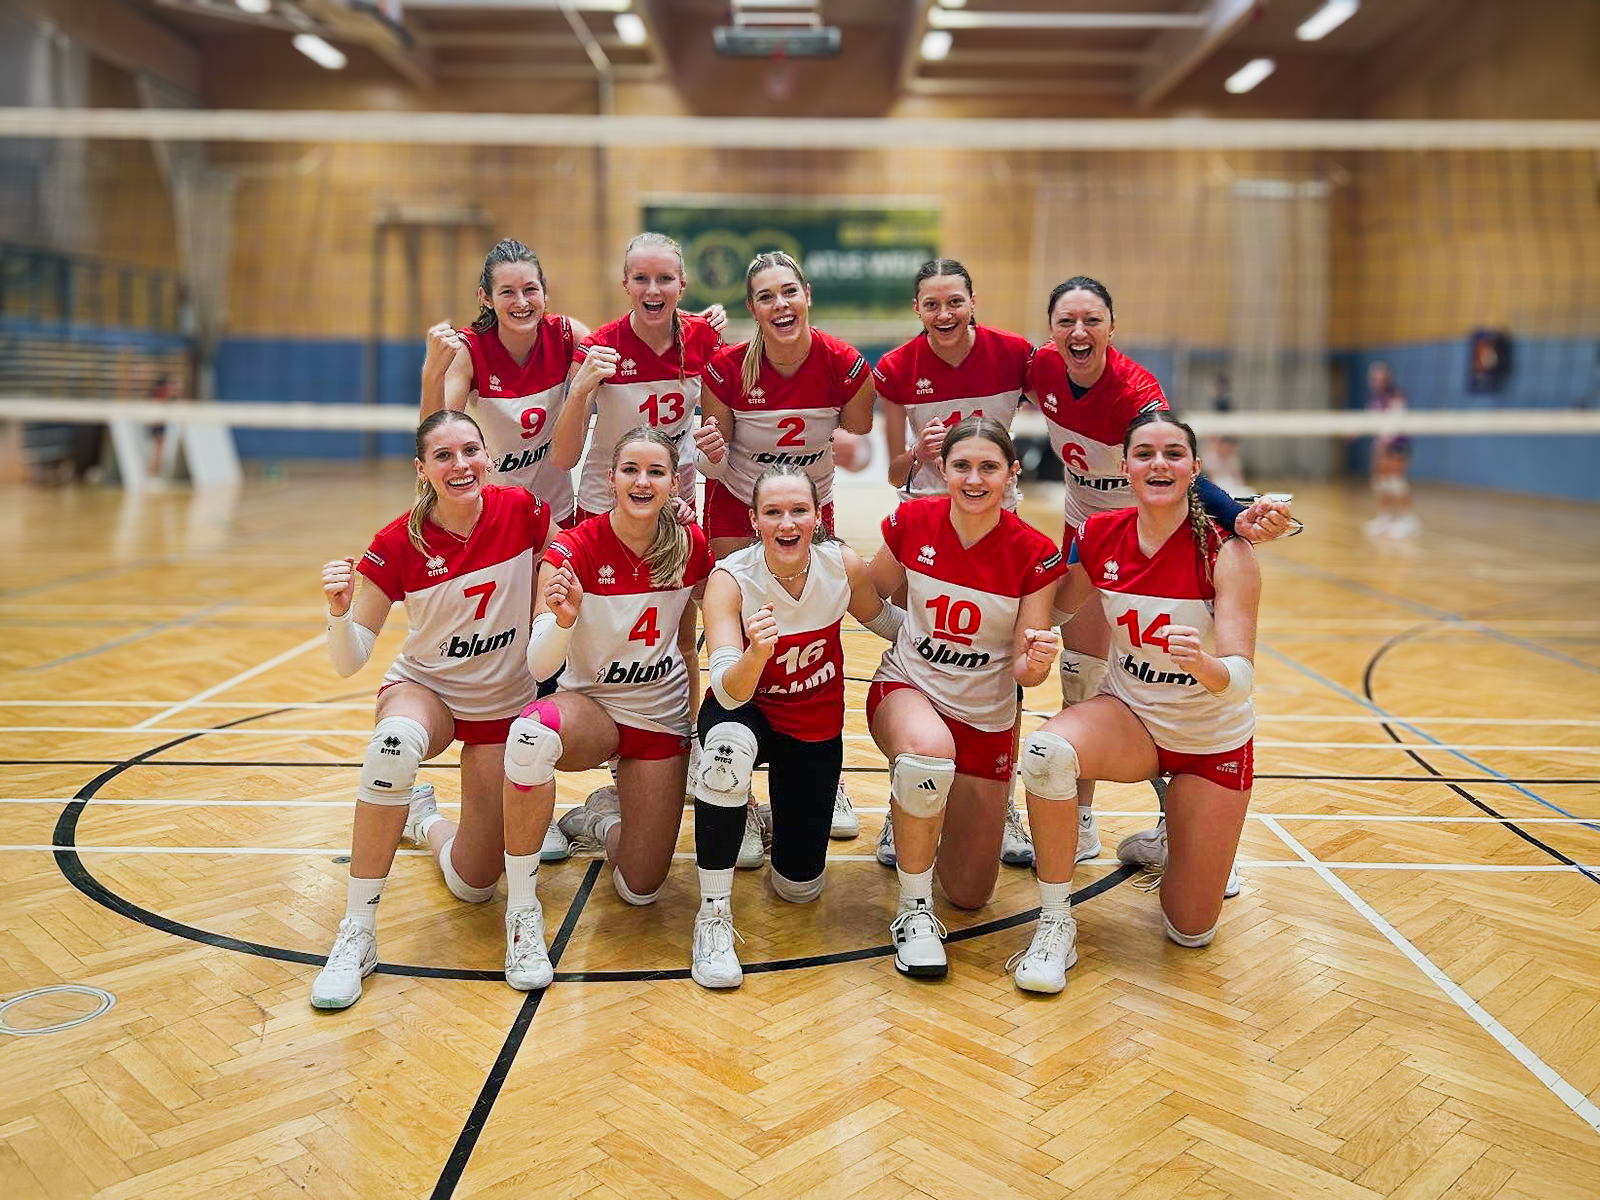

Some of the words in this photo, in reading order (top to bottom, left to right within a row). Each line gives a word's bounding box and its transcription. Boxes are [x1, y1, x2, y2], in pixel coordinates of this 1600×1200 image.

[520, 407, 547, 440] 9
[638, 392, 685, 428] 13
[776, 416, 806, 447] 2
[1061, 442, 1089, 471] 6
[463, 581, 497, 621] 7
[925, 594, 982, 636] 10
[447, 627, 517, 659] blum
[628, 607, 661, 647] 4
[1116, 608, 1171, 654] 14
[604, 655, 673, 684] blum
[776, 638, 827, 676] 16
[916, 637, 990, 669] blum
[1124, 654, 1198, 687] blum
